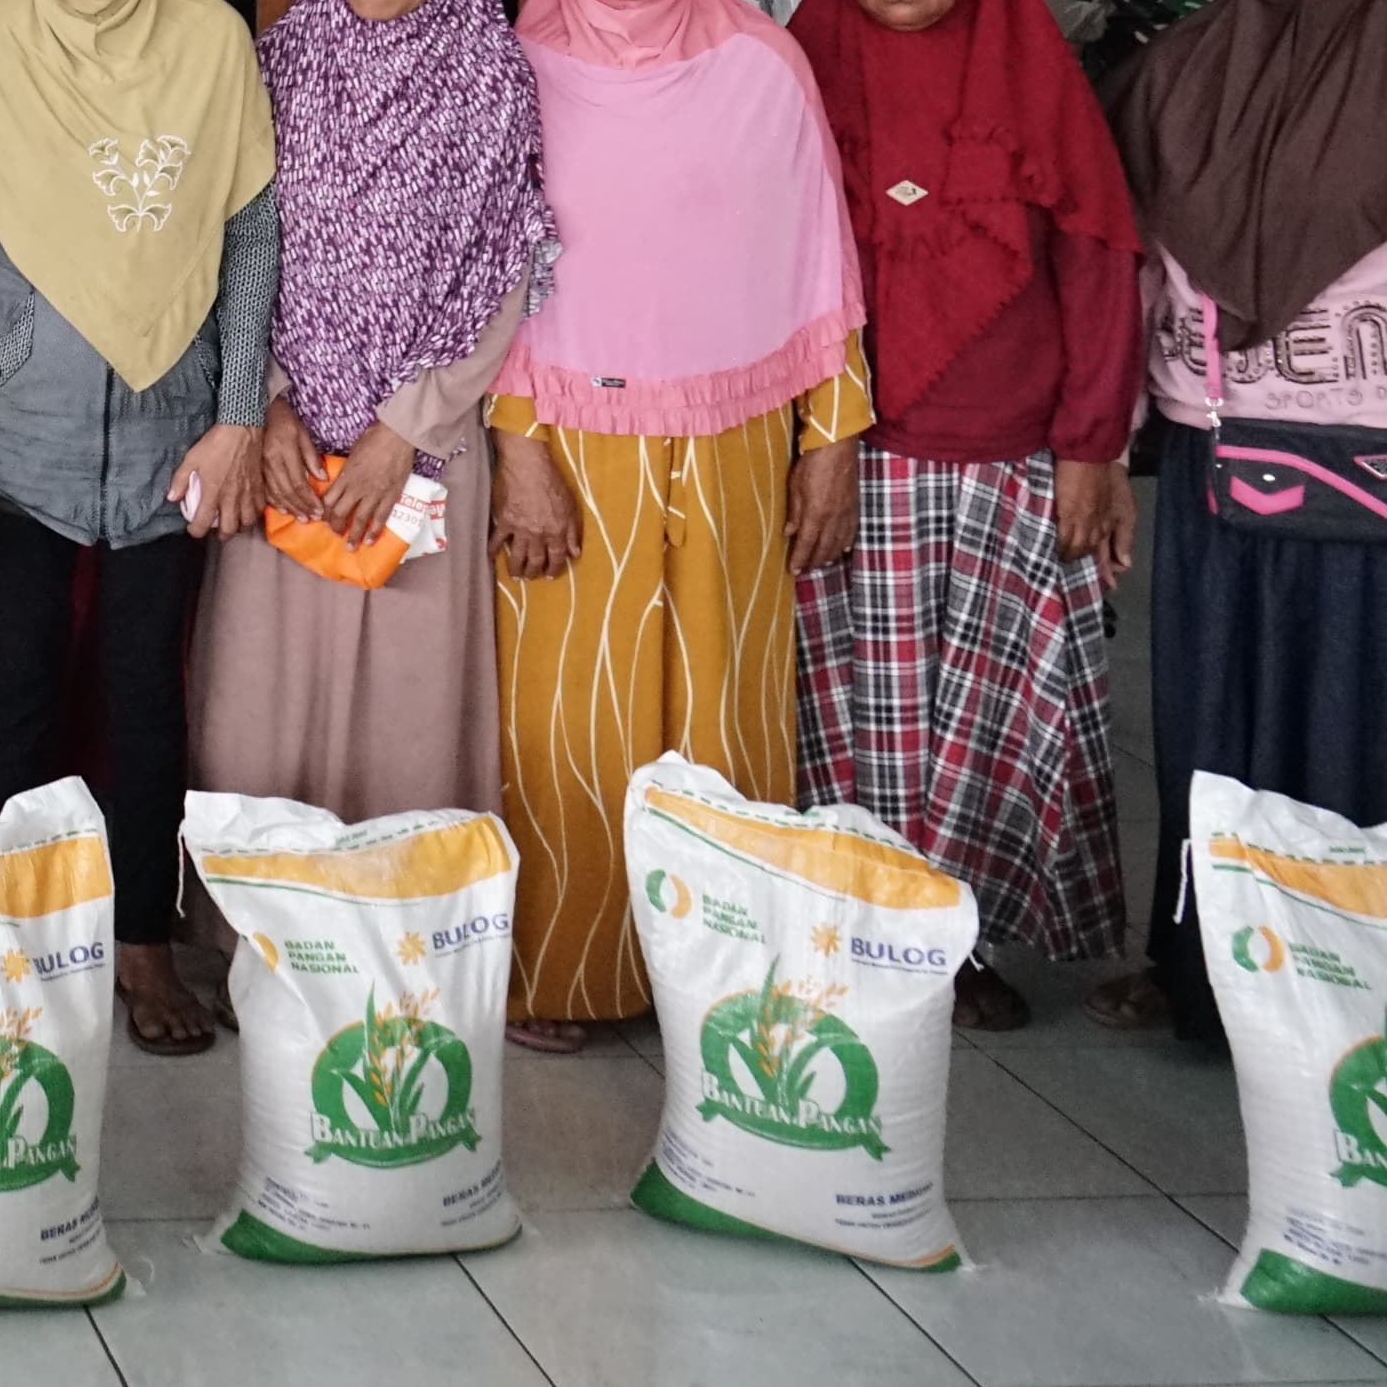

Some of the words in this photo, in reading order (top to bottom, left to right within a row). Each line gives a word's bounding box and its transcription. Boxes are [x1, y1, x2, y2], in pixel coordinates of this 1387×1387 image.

[284, 939, 335, 951] BADAN
[851, 937, 947, 967] BULOG
[288, 951, 347, 962] PANGAN
[291, 961, 360, 975] NASIONAL
[702, 1068, 791, 1126] BANTUAN
[794, 1098, 883, 1135] PANGAN
[311, 1112, 404, 1148] BANTUAN
[407, 1109, 476, 1145] PANGAN
[4, 1134, 76, 1170] PANGAN
[835, 1194, 886, 1206] BERAS
